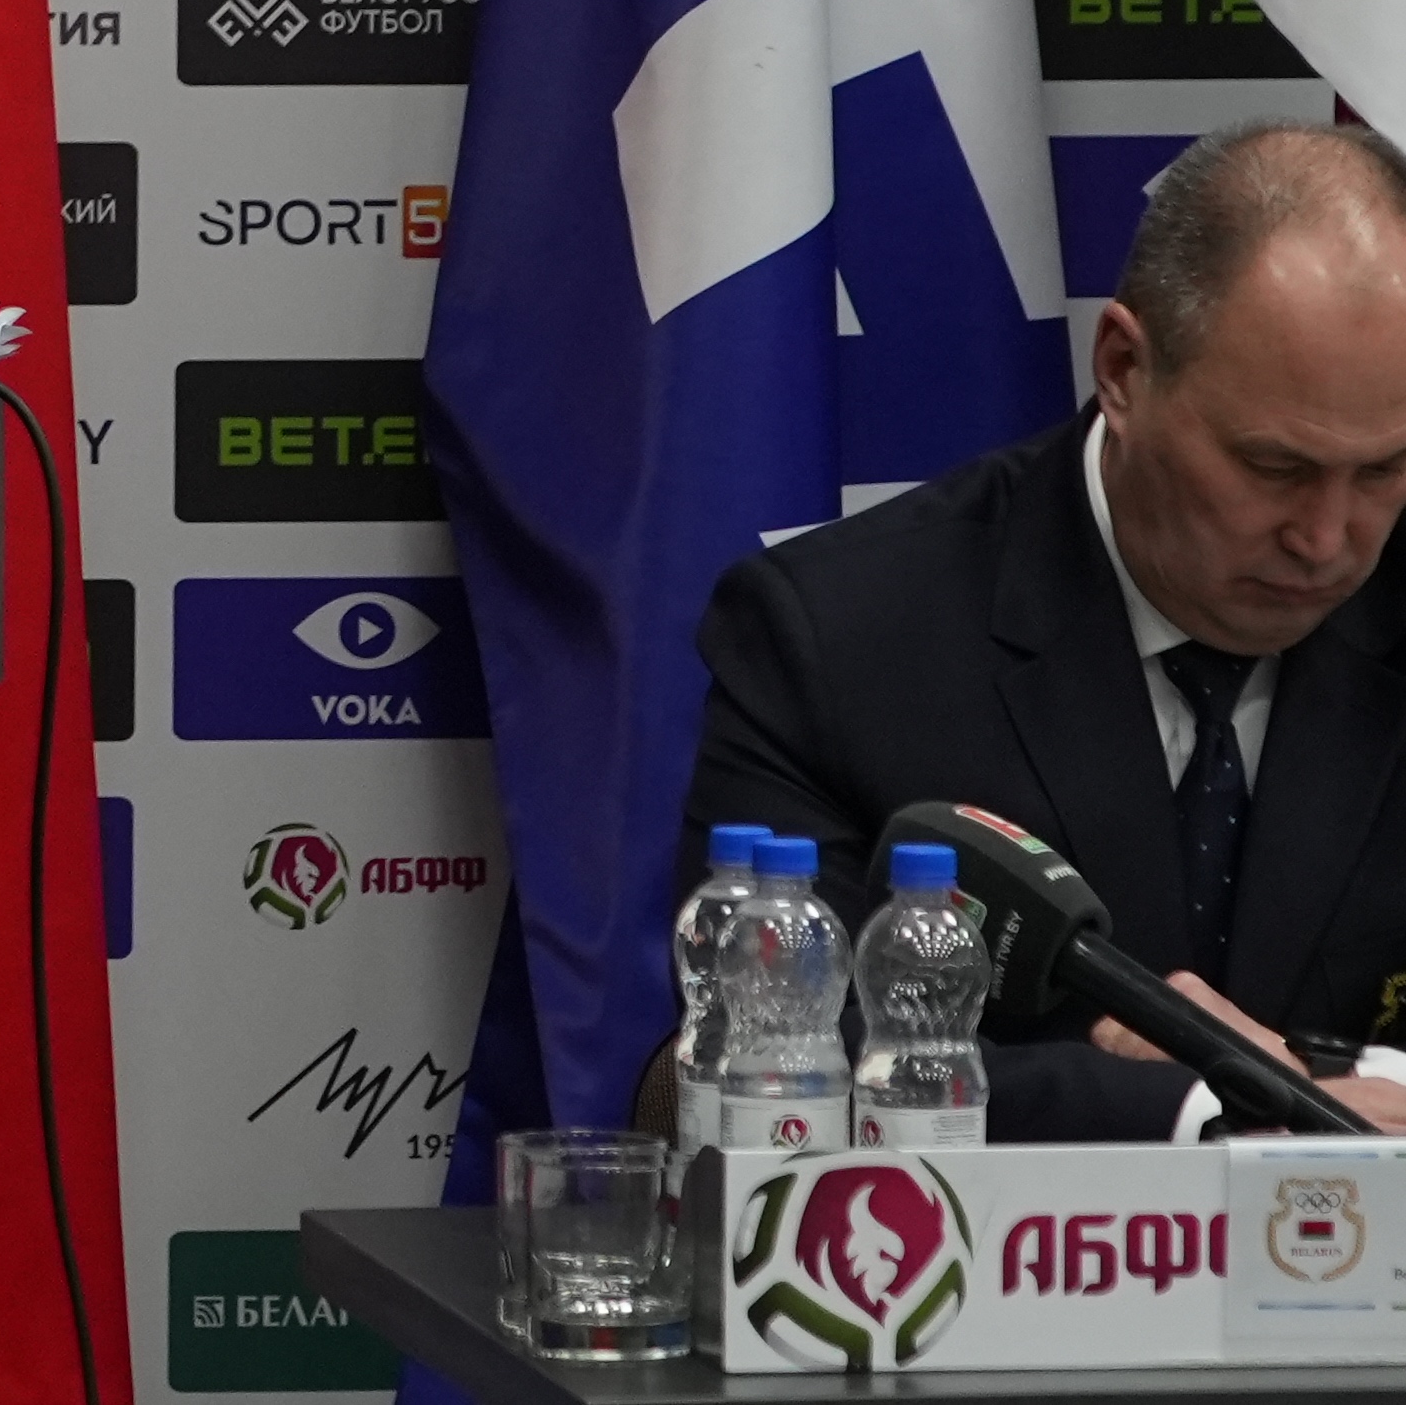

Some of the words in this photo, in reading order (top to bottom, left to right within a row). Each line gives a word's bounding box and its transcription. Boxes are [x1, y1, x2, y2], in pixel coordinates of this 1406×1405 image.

[49, 12, 120, 46] ИЯ
[320, 8, 444, 34] ФУТБОЛ
[311, 695, 422, 726] VOKA
[361, 857, 487, 895] АБФФ
[1291, 1247, 1344, 1258] BELARUS
[236, 1294, 348, 1328] БЕЛА
